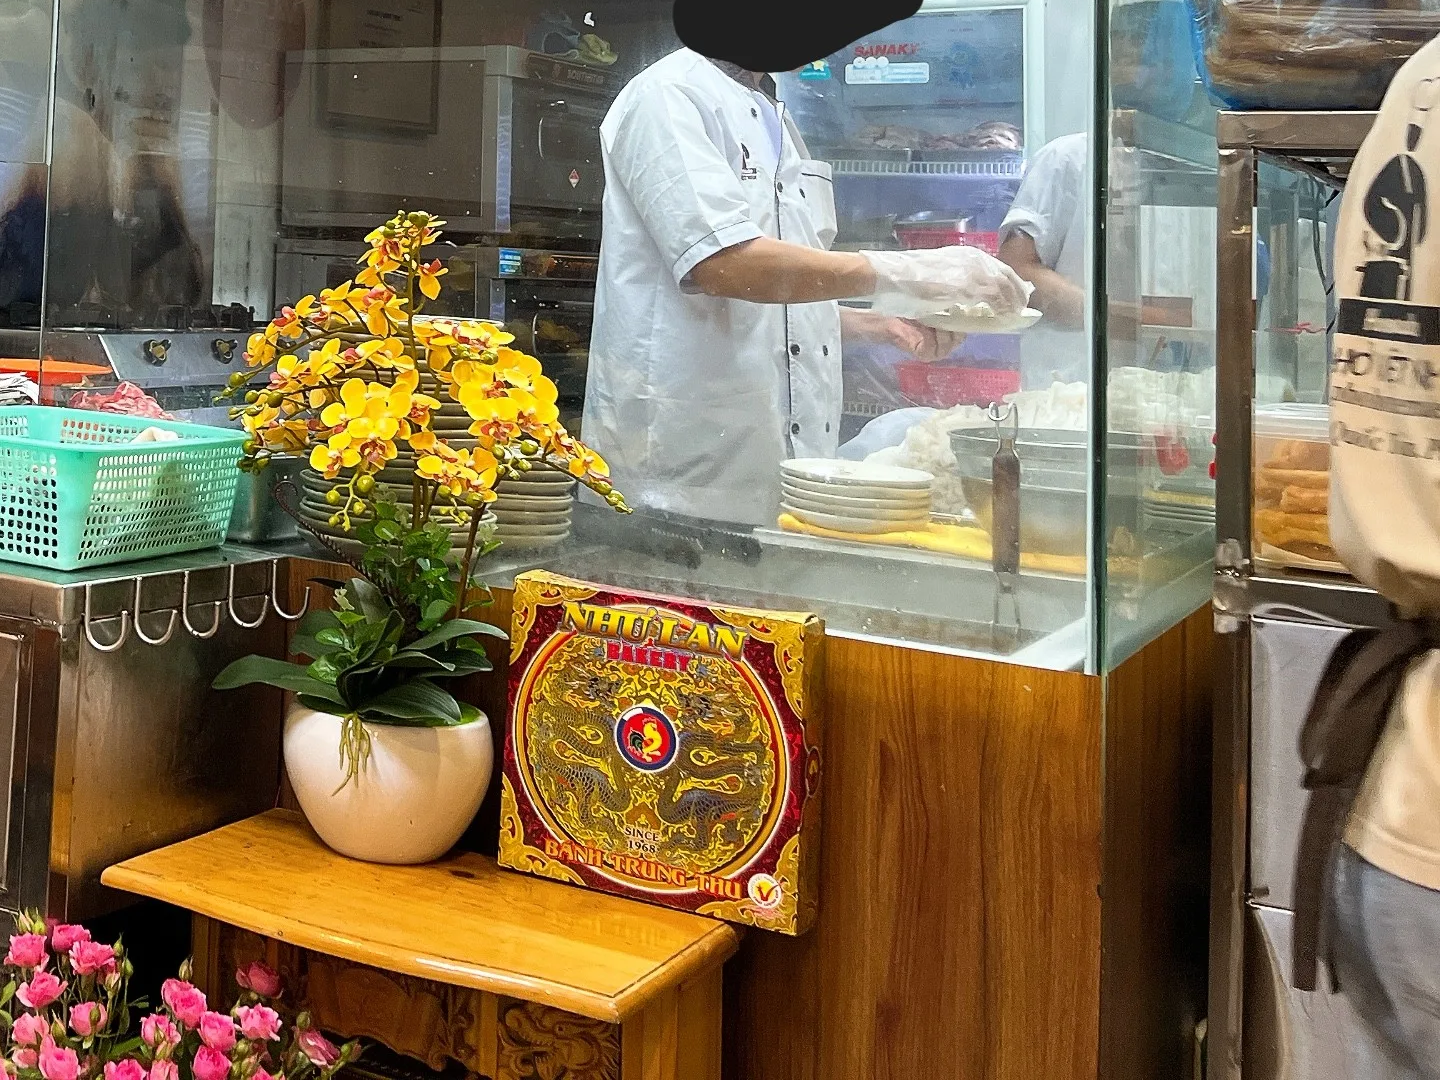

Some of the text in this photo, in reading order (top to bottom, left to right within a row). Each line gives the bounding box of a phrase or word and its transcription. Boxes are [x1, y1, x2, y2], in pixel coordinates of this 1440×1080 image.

[658, 619, 748, 660] LAN
[606, 641, 692, 672] BAKERY
[624, 826, 659, 842] SINCE
[628, 840, 656, 853] 1968
[611, 852, 687, 887] TRUNG
[694, 872, 742, 900] THU
